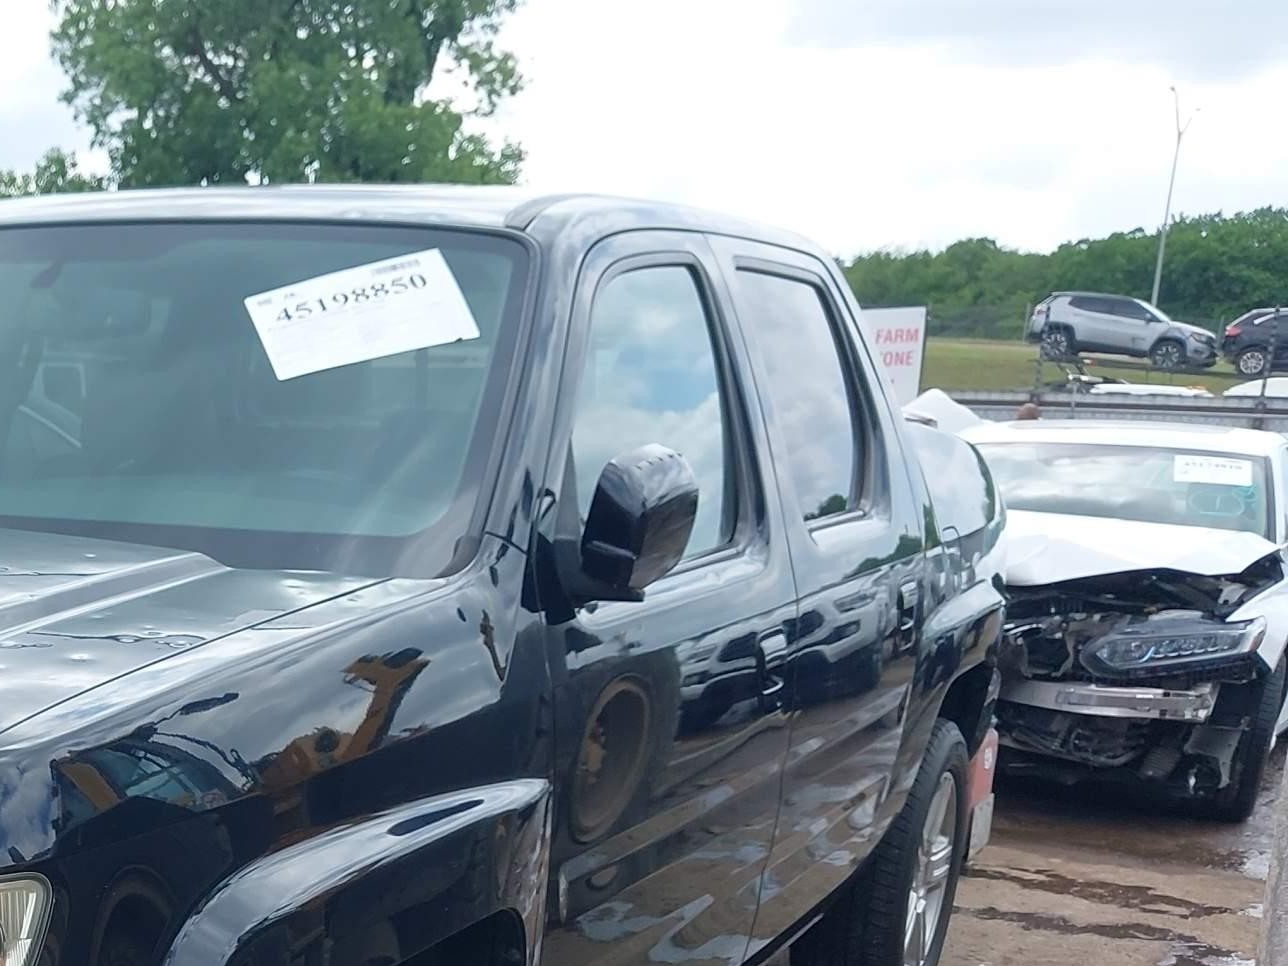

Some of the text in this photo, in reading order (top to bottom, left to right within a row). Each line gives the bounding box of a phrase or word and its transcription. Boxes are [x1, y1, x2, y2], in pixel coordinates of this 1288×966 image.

[276, 273, 428, 322] 45198850
[875, 327, 919, 345] FARM
[880, 350, 915, 367] ONE
